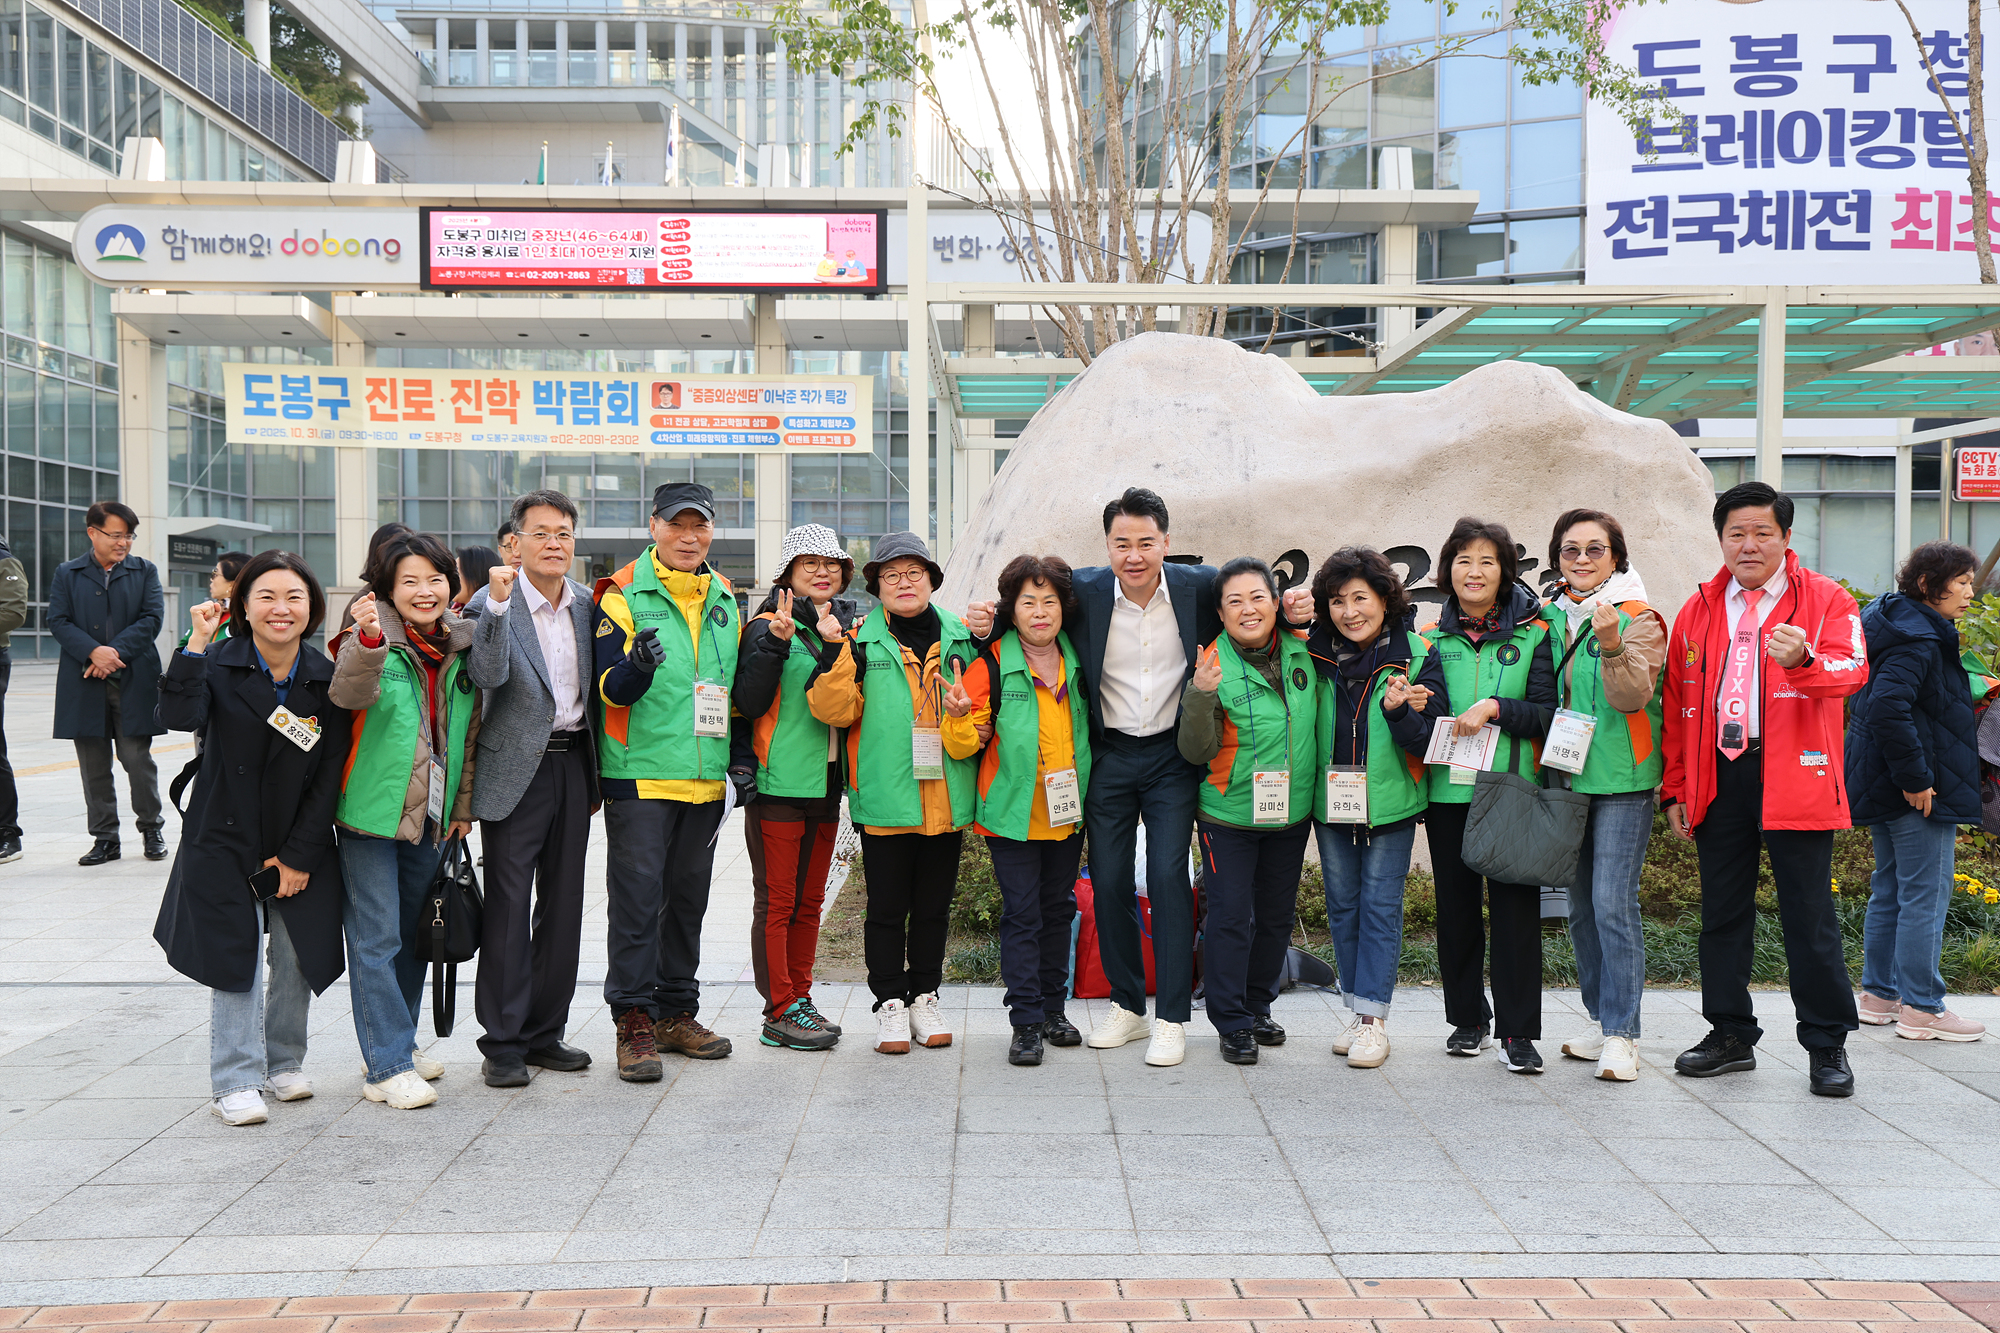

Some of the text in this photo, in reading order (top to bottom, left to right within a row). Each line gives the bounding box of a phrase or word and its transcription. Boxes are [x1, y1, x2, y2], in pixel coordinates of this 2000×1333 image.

[1603, 188, 1872, 260] 전국체전
[443, 229, 649, 242] 도봉구 미취업 중장년(46~64세)
[162, 225, 402, 263] 함께해요! dobong
[436, 246, 479, 258] 자격증
[524, 246, 545, 258] 1인
[549, 246, 576, 258] 최대
[579, 246, 625, 259] 10만원
[628, 246, 655, 259] 지원
[526, 271, 590, 280] 02-2091-2863
[243, 374, 639, 426] 도봉구 진로·진학 박람회
[800, 389, 822, 405] 작가
[825, 389, 848, 405] 특강
[339, 431, 398, 441] 09:30~16:00
[425, 432, 462, 443] 도봉구청
[486, 434, 509, 443] 도봉구
[559, 434, 639, 445] 02-2091-2302
[787, 434, 810, 444] 이벤트
[811, 434, 842, 445] 프로그램
[1961, 451, 1998, 464] CCTV
[1729, 700, 1740, 715] C
[1259, 801, 1284, 812] 김미선
[1332, 801, 1361, 812] 유희숙
